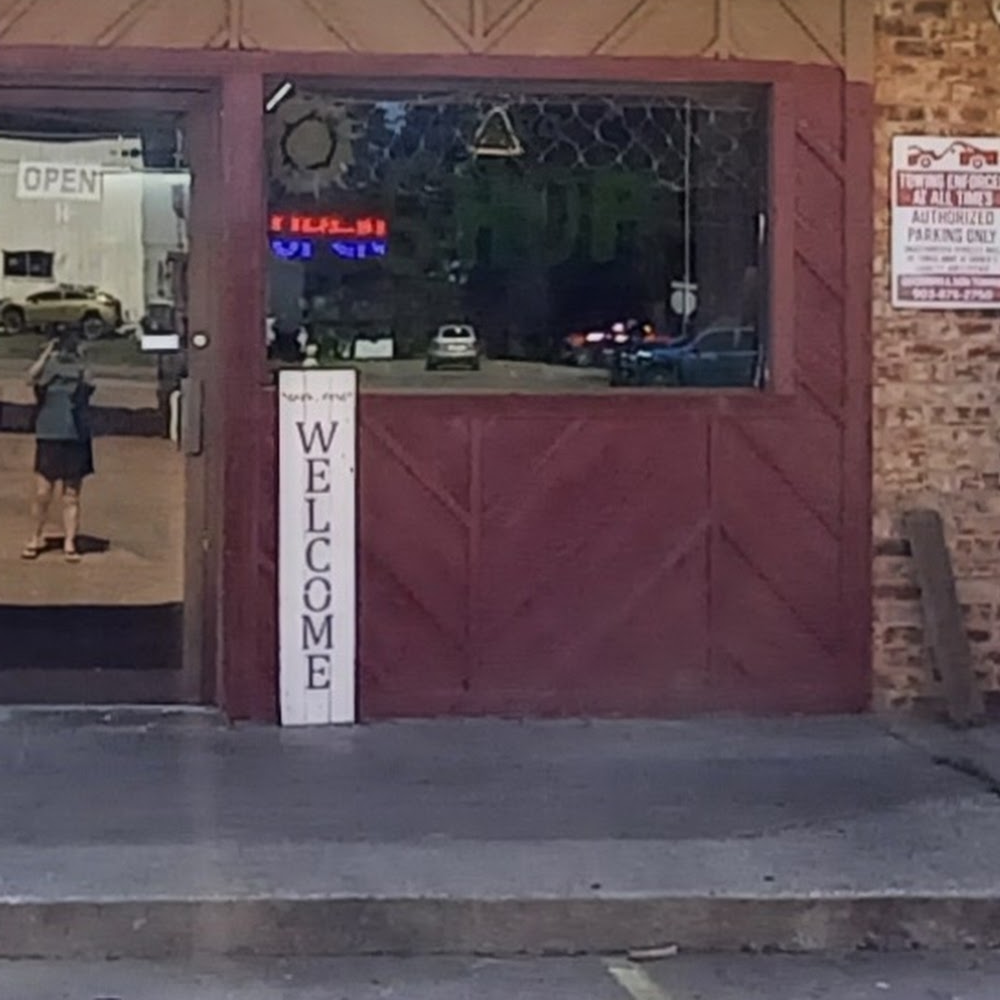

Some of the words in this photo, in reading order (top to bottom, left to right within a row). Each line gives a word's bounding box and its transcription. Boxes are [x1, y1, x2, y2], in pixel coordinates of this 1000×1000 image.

[23, 166, 97, 194] OPEN
[911, 210, 995, 226] AUTHORIZED
[908, 228, 963, 244] PARKING
[966, 229, 997, 244] ONLY
[295, 421, 339, 690] WELCOME
